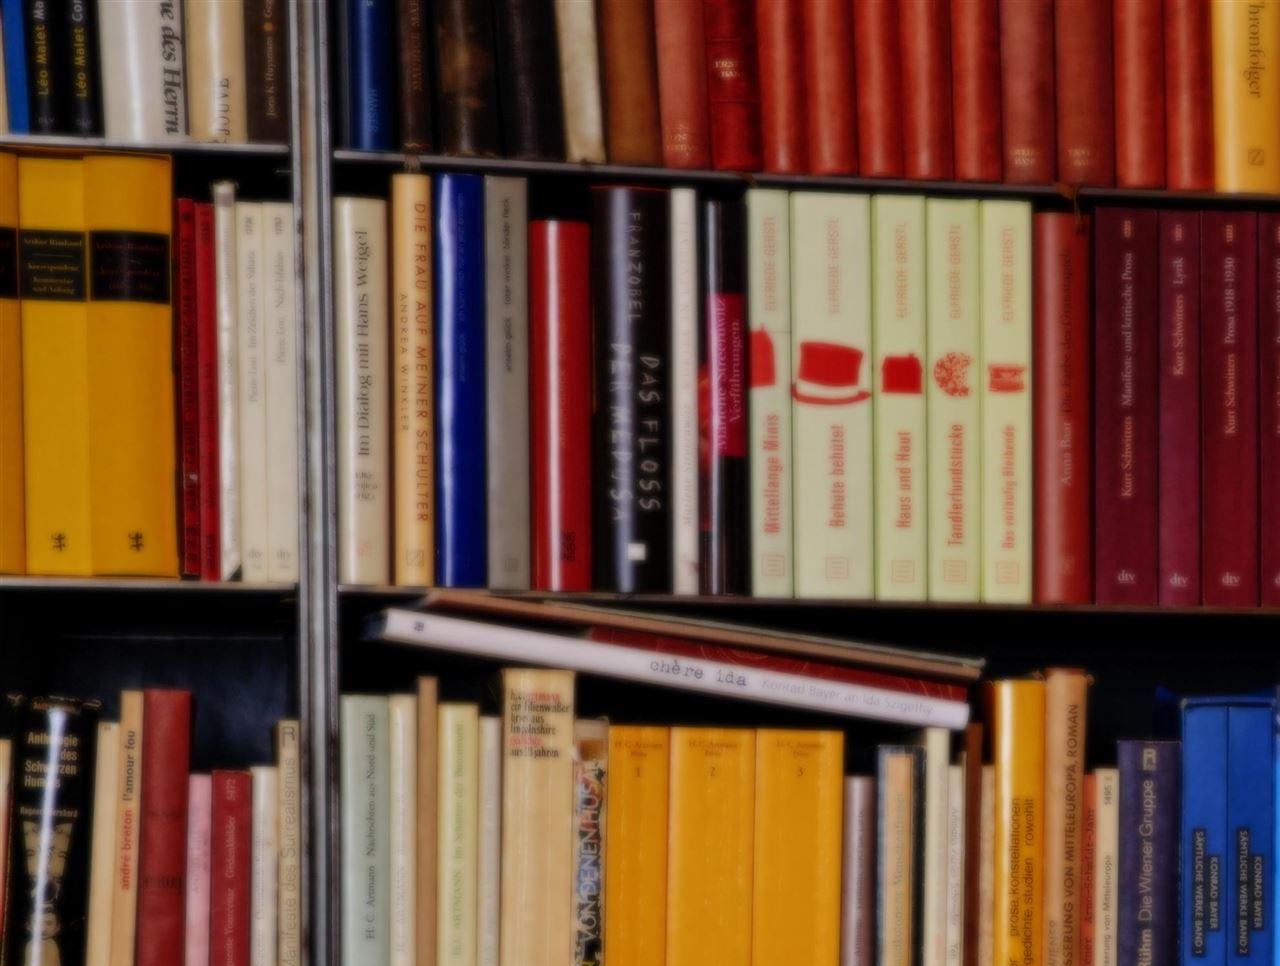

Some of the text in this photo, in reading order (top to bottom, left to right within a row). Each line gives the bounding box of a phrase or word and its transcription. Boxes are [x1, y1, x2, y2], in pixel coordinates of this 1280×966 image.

[354, 229, 373, 287] Weigel
[1120, 251, 1134, 281] Prosa
[354, 291, 371, 338] Hans
[1171, 255, 1186, 377] Kurt Schwitters Lyrik
[414, 202, 430, 523] DIE FRAU AUF MEINER SCHULTER
[1120, 330, 1134, 353] und
[1120, 355, 1134, 407] Manifeste
[1223, 315, 1237, 436] Kurt Schwitters Prosa
[638, 355, 661, 513] DAS FLOSS
[1120, 415, 1134, 471] Schwitters
[1121, 471, 1134, 498] Kurt
[649, 659, 705, 680] chère
[715, 669, 747, 687] ida
[1066, 704, 1079, 757] ROMAN
[120, 808, 133, 851] breton
[1139, 780, 1157, 838] Gruppe
[281, 863, 297, 892] des
[1022, 857, 1035, 905] studien
[1064, 866, 1076, 899] VON
[1138, 839, 1153, 895] Wiener
[1138, 897, 1152, 922] Die
